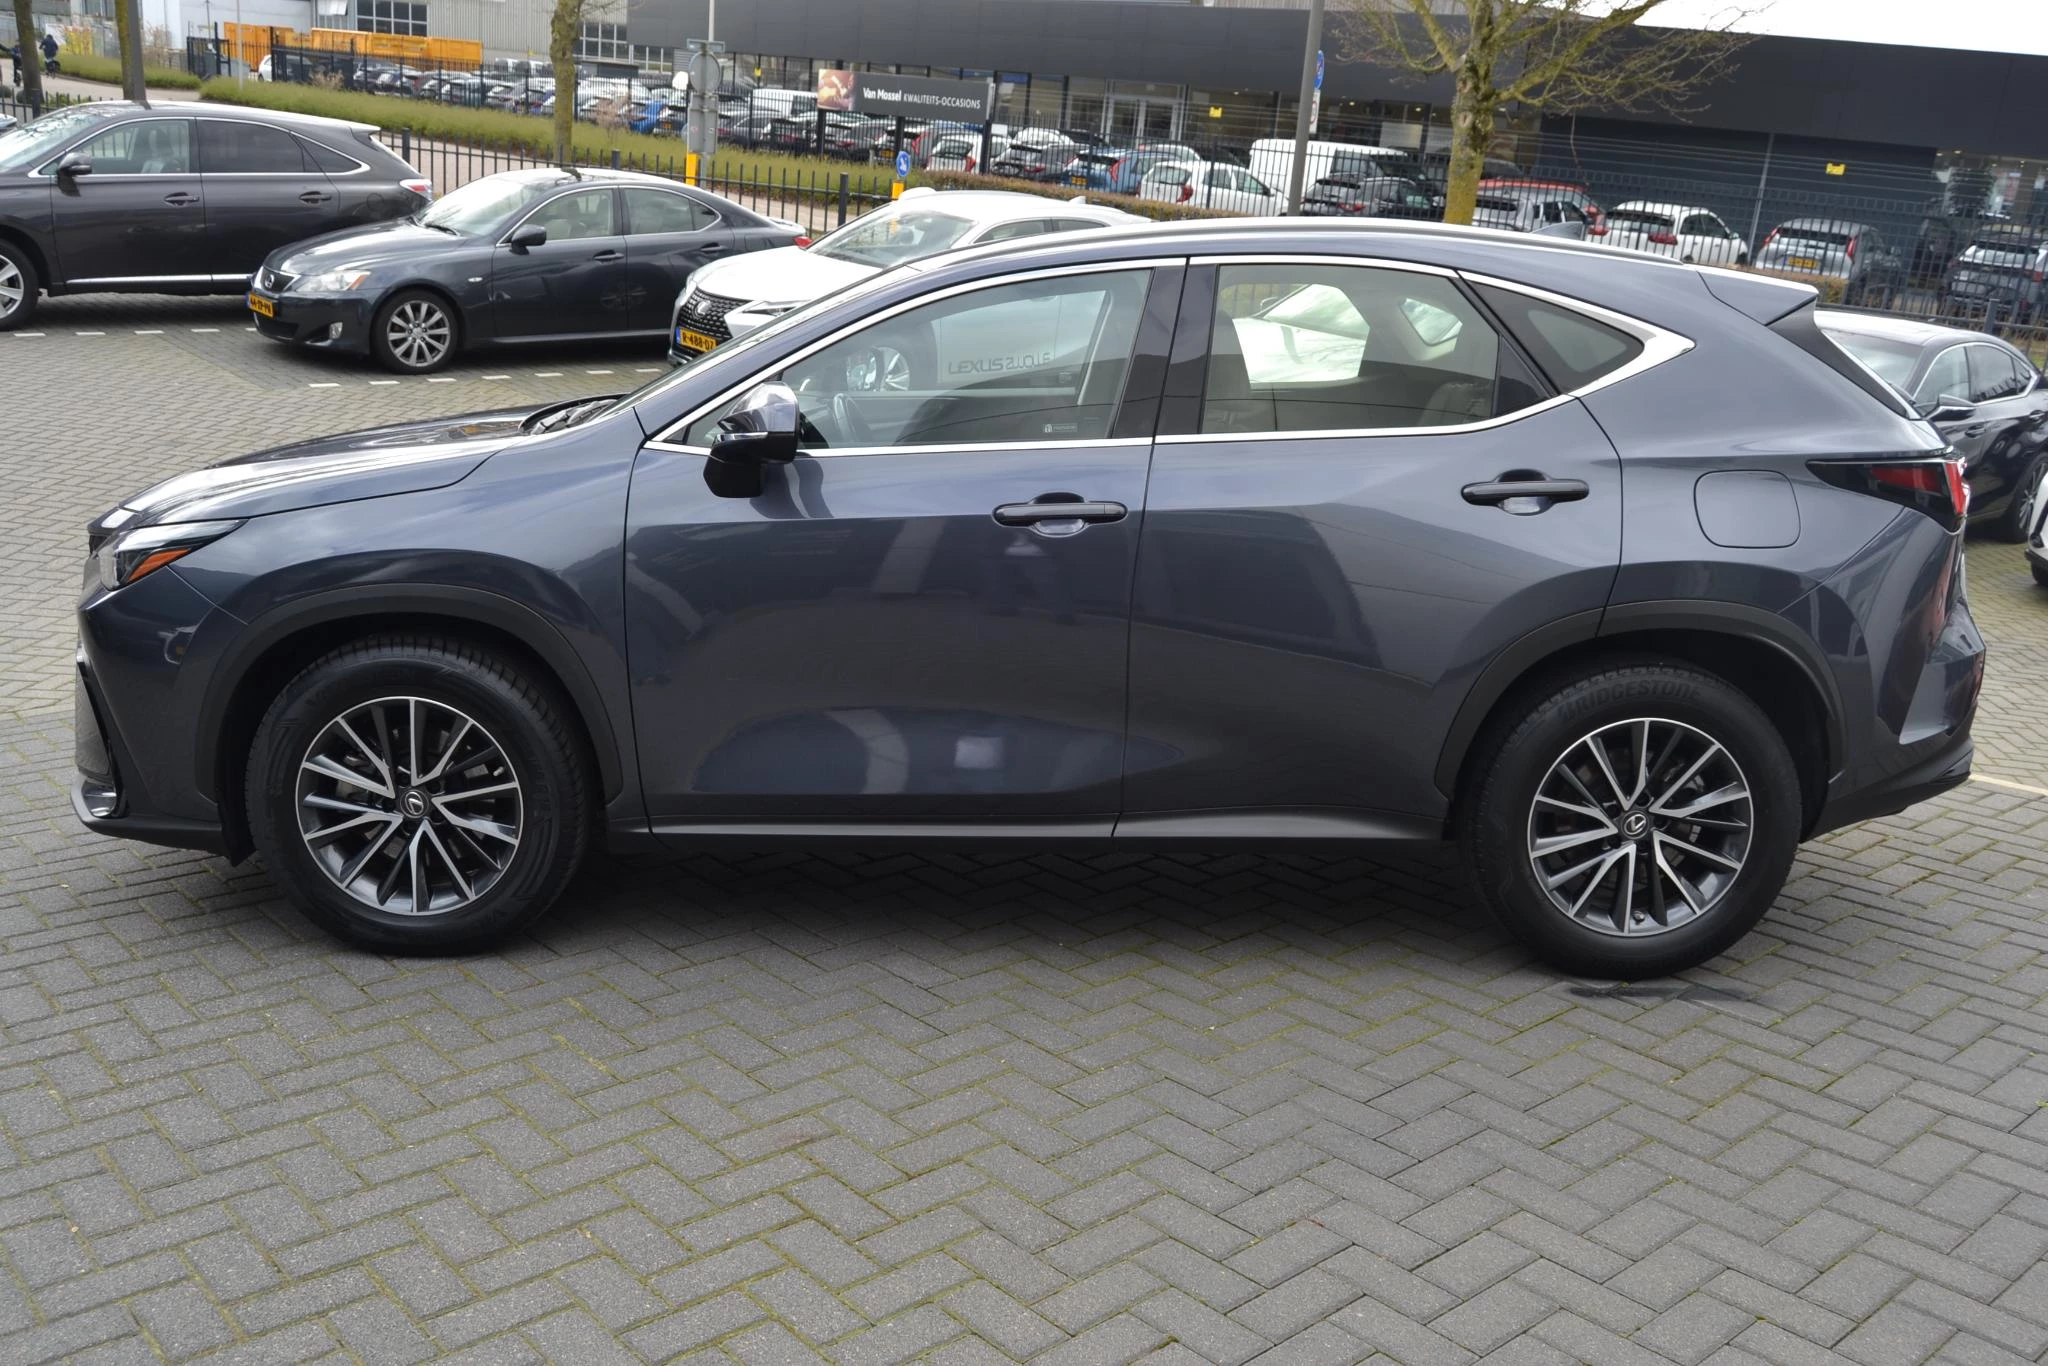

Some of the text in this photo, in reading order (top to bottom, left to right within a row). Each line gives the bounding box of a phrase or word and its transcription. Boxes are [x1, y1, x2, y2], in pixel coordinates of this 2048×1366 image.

[863, 87, 981, 109] Van Mossel KWALITEITS-OCCASIONS
[948, 357, 1004, 375] LEXUS
